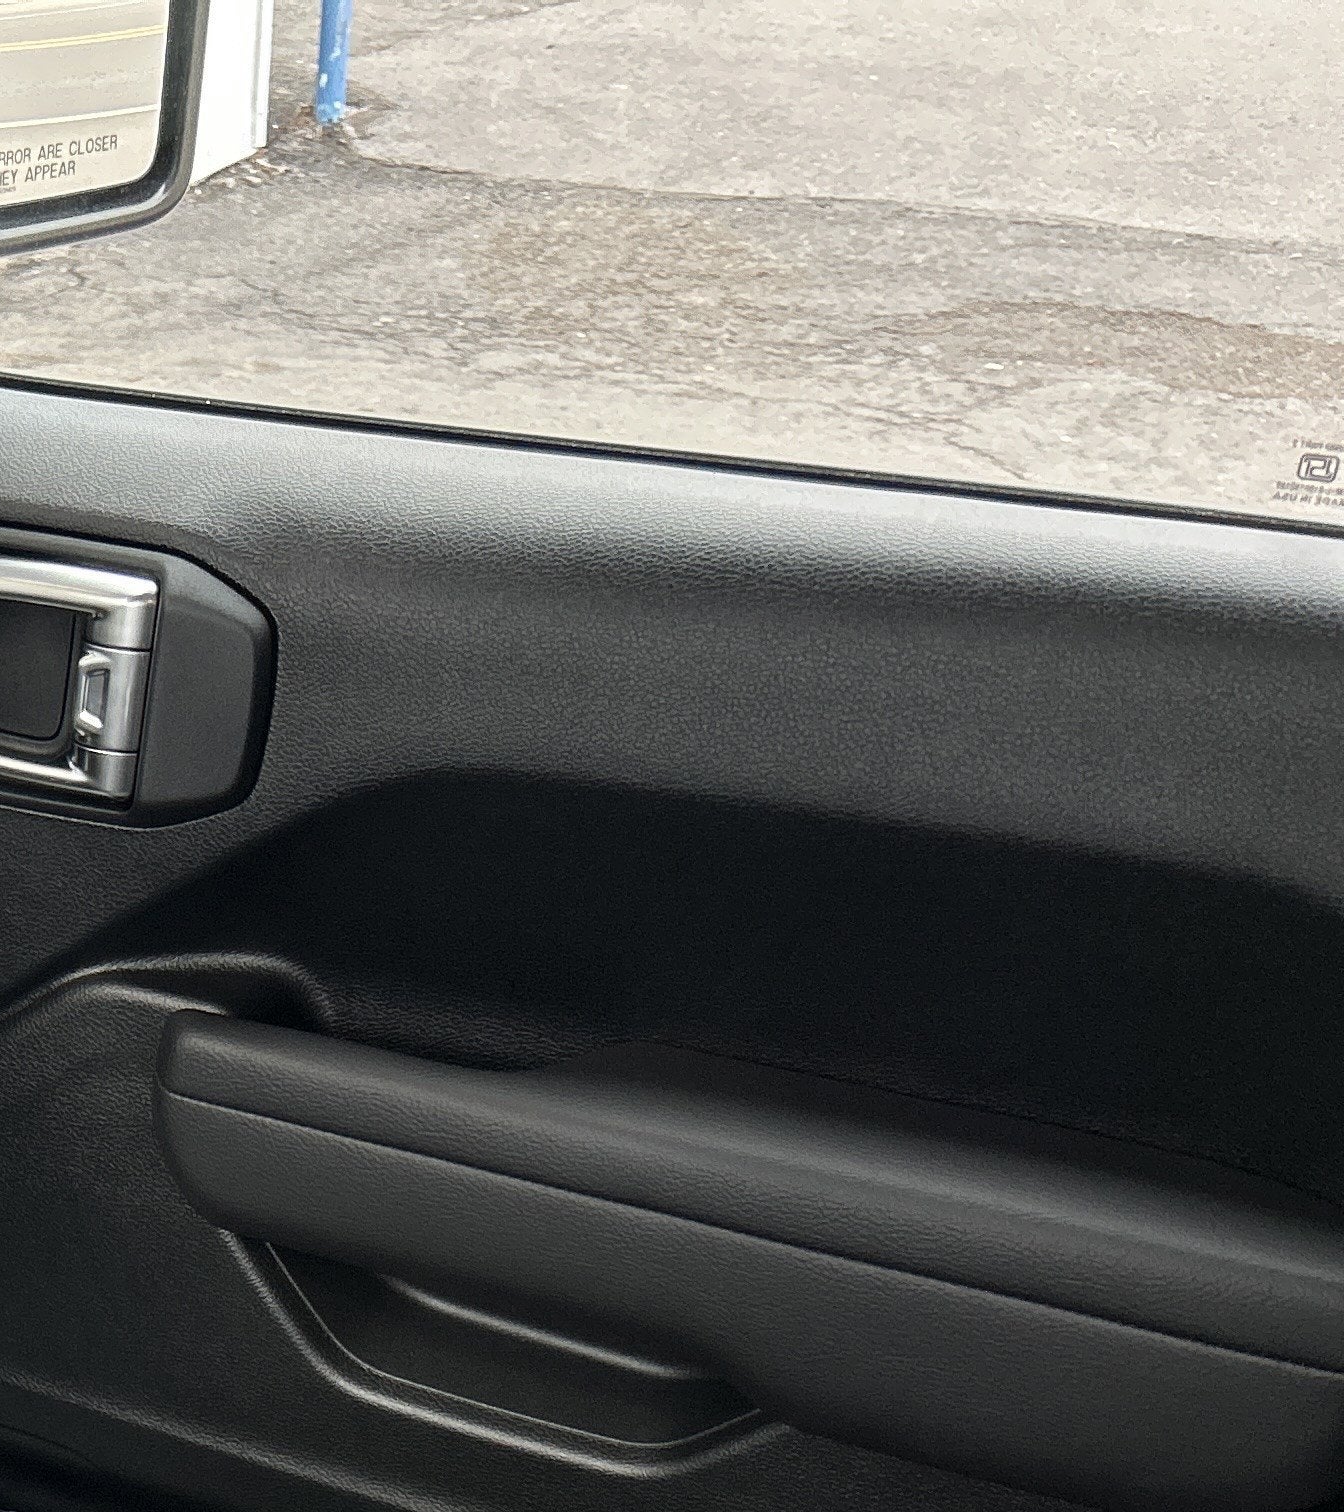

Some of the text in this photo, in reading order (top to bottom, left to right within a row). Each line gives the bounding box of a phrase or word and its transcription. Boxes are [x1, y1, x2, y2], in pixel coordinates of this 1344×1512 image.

[37, 143, 63, 161] ARE
[69, 134, 118, 156] CLOSER
[25, 160, 76, 182] APPEAR
